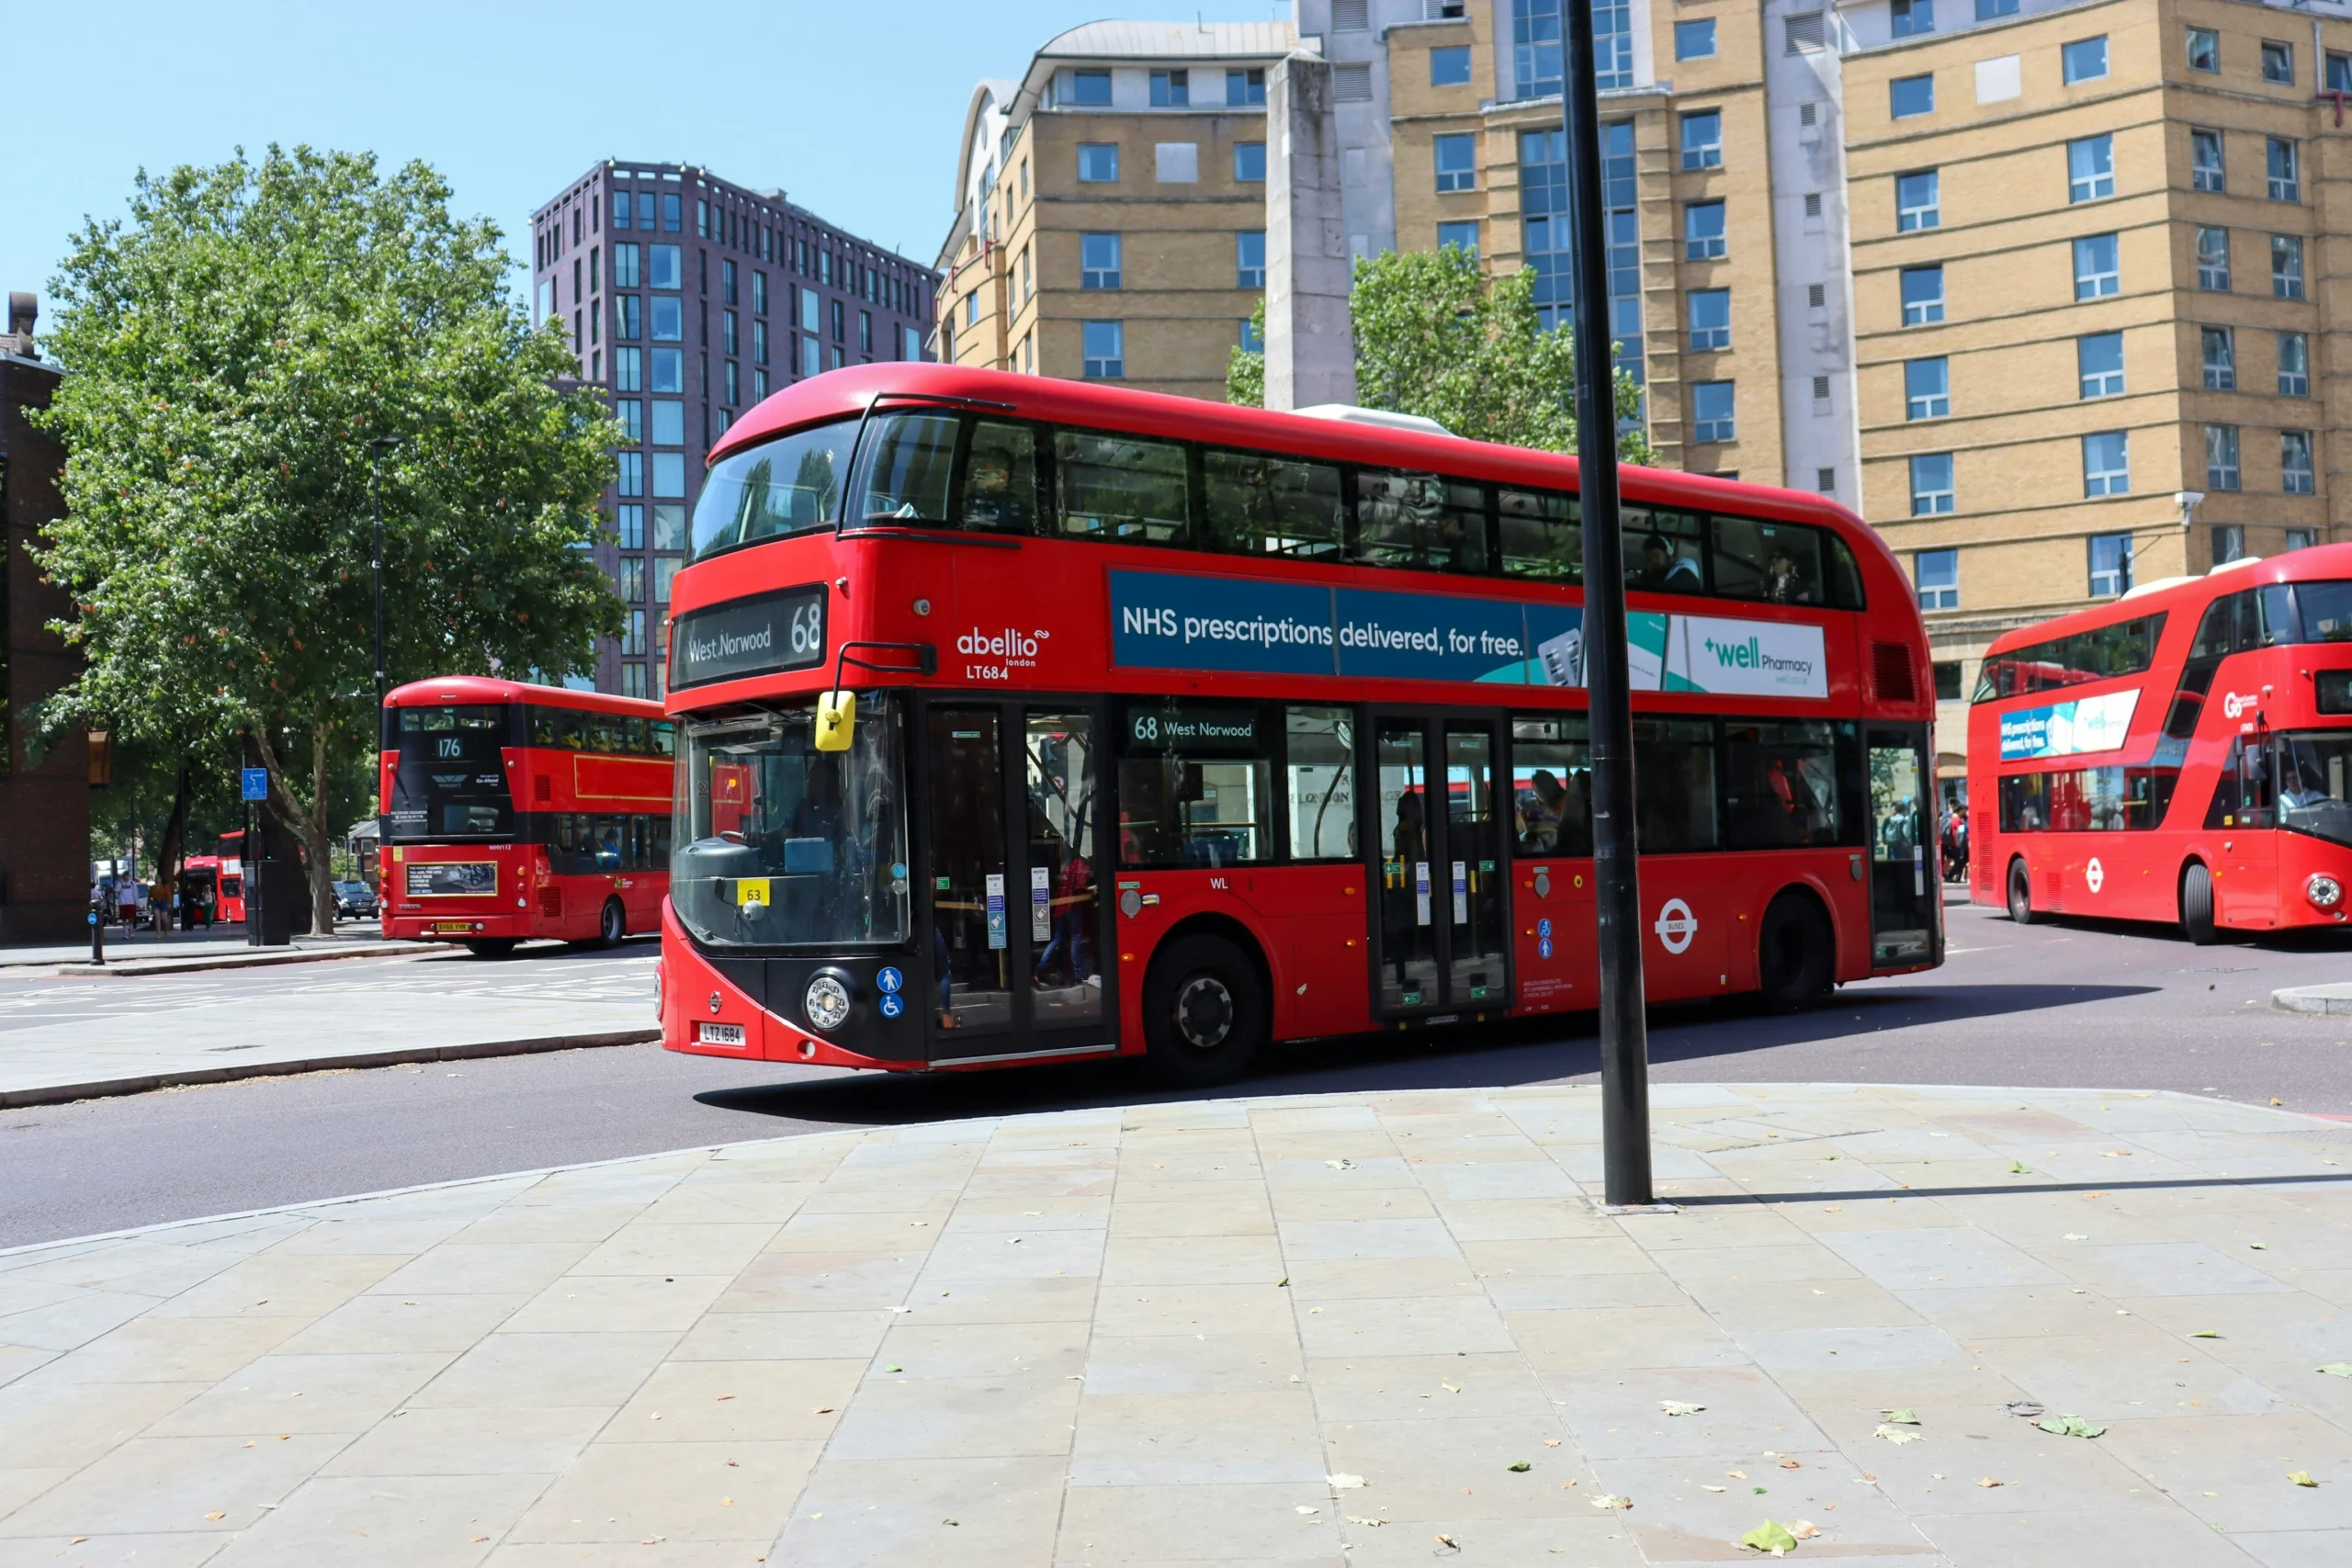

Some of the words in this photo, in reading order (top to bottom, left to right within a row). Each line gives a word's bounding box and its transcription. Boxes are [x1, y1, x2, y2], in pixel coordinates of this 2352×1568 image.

[791, 603, 820, 653] 68
[1123, 606, 1178, 637] NHS
[1184, 615, 1333, 649] prescriptions
[1340, 621, 1443, 656] delivered,
[1448, 627, 1476, 653] for
[1480, 629, 1523, 657] free.
[689, 637, 717, 662] West
[720, 623, 771, 656] Norwood
[956, 626, 1038, 658] abellio
[1005, 658, 1036, 667] london
[1762, 654, 1812, 675] Pharmacy
[966, 665, 1009, 681] LT684
[1135, 716, 1158, 739] 68
[1164, 722, 1195, 736] West
[1199, 722, 1252, 737] Norwood
[438, 738, 460, 757] 176
[1210, 877, 1228, 889] WL
[747, 889, 761, 901] 63
[1668, 921, 1684, 931] BUSES
